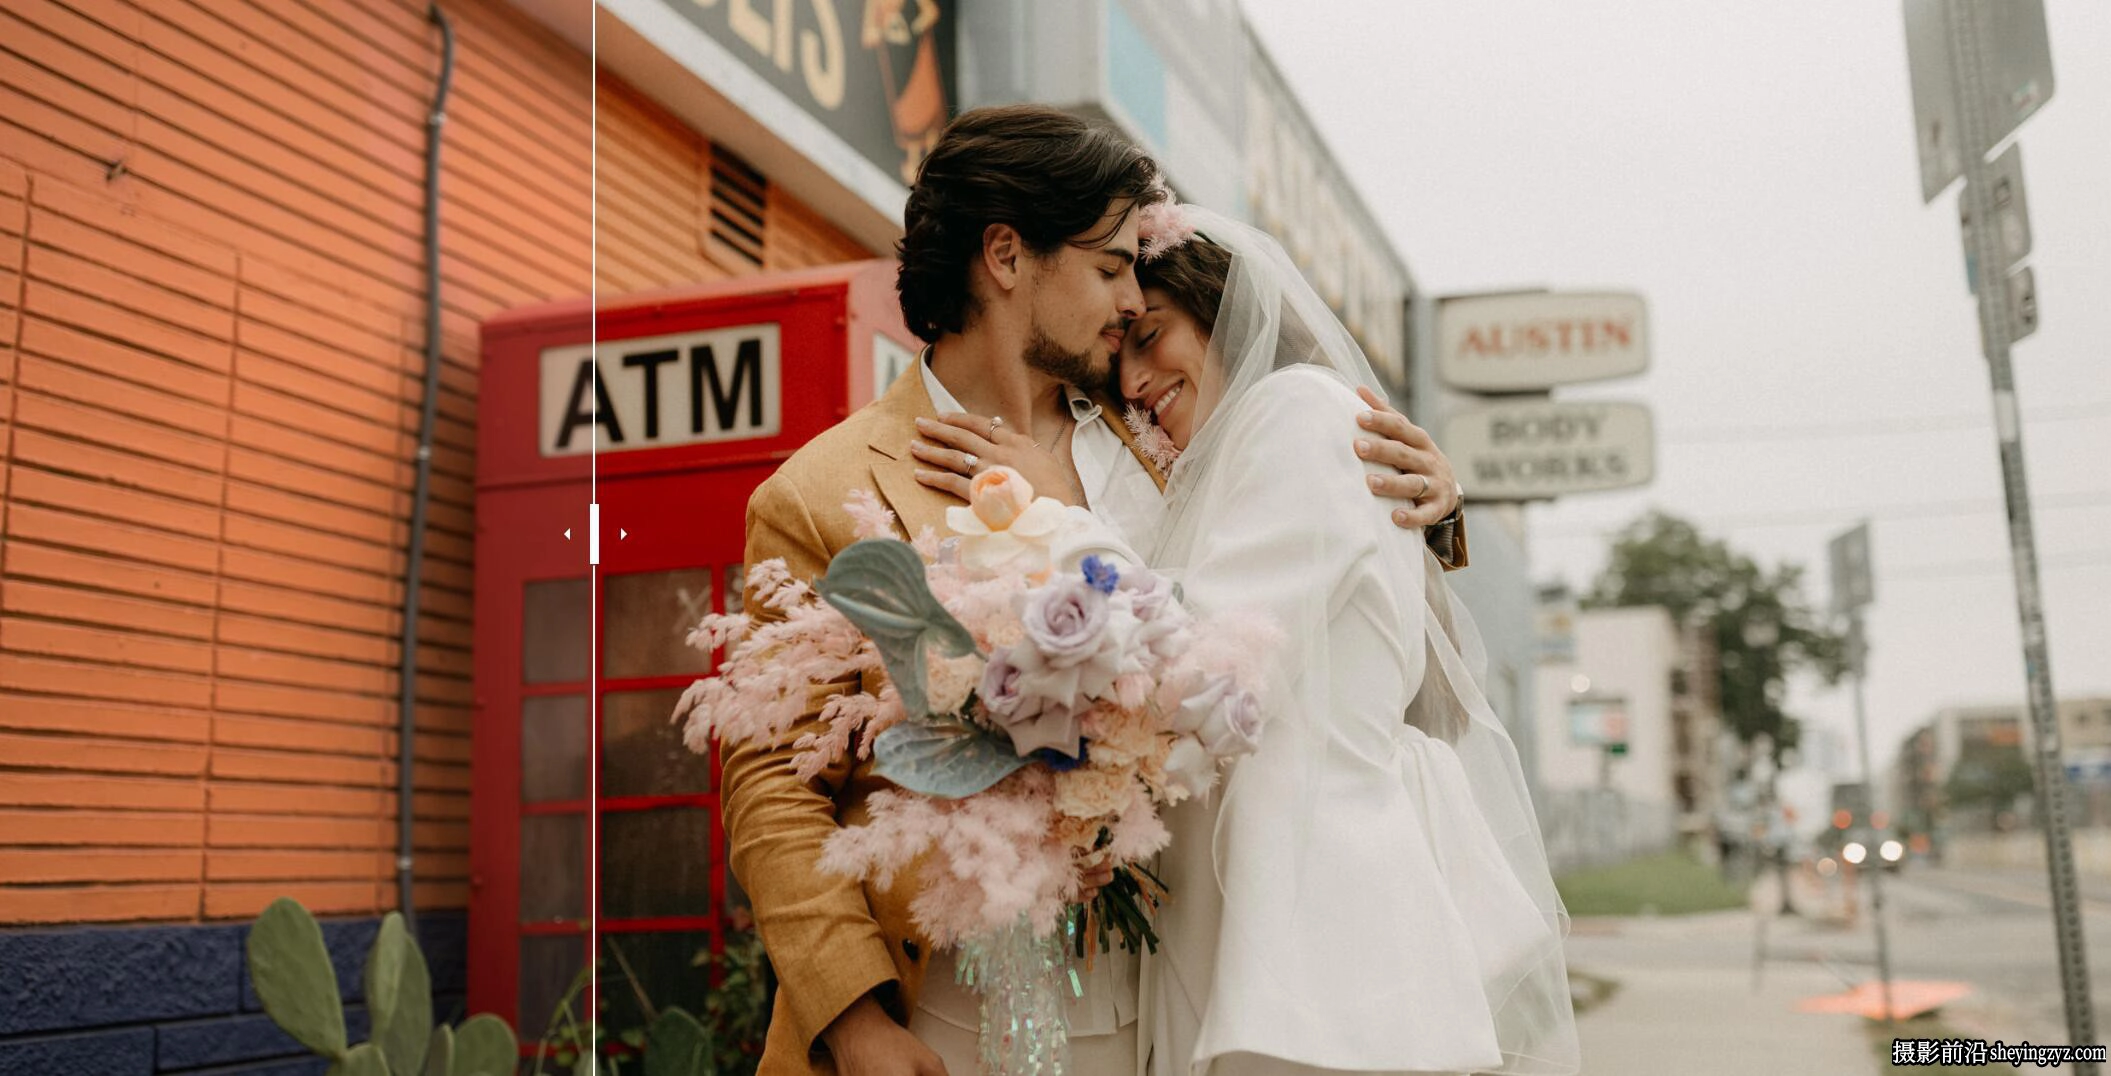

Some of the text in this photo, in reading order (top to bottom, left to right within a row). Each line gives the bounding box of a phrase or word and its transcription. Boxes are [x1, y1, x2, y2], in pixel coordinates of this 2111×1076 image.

[1456, 317, 1633, 359] AUSTIN
[555, 338, 763, 449] ATM
[1488, 410, 1605, 446] BODY
[1470, 452, 1630, 486] WORKS
